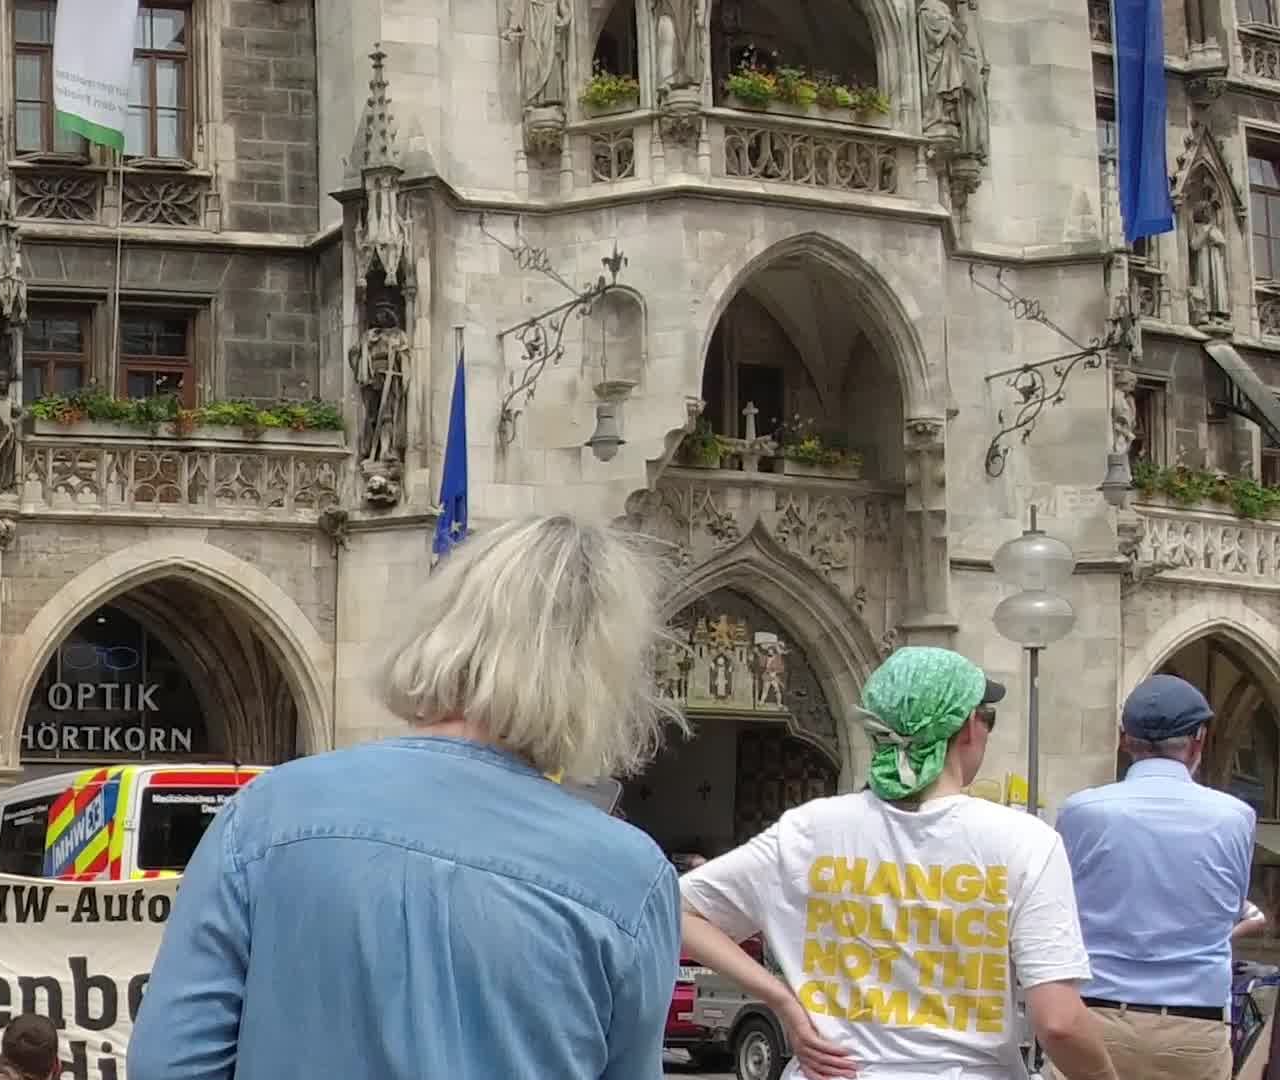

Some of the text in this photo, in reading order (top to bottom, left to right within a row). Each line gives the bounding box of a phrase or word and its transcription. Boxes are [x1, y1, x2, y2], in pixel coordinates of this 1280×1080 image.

[48, 682, 160, 711] OPTIK
[21, 722, 192, 752] HÖRTKORN
[808, 856, 1008, 903] CHANGE
[806, 898, 1008, 948] POLITICS
[801, 941, 1007, 991] NOT THE
[798, 980, 1004, 1033] CLIMATE
